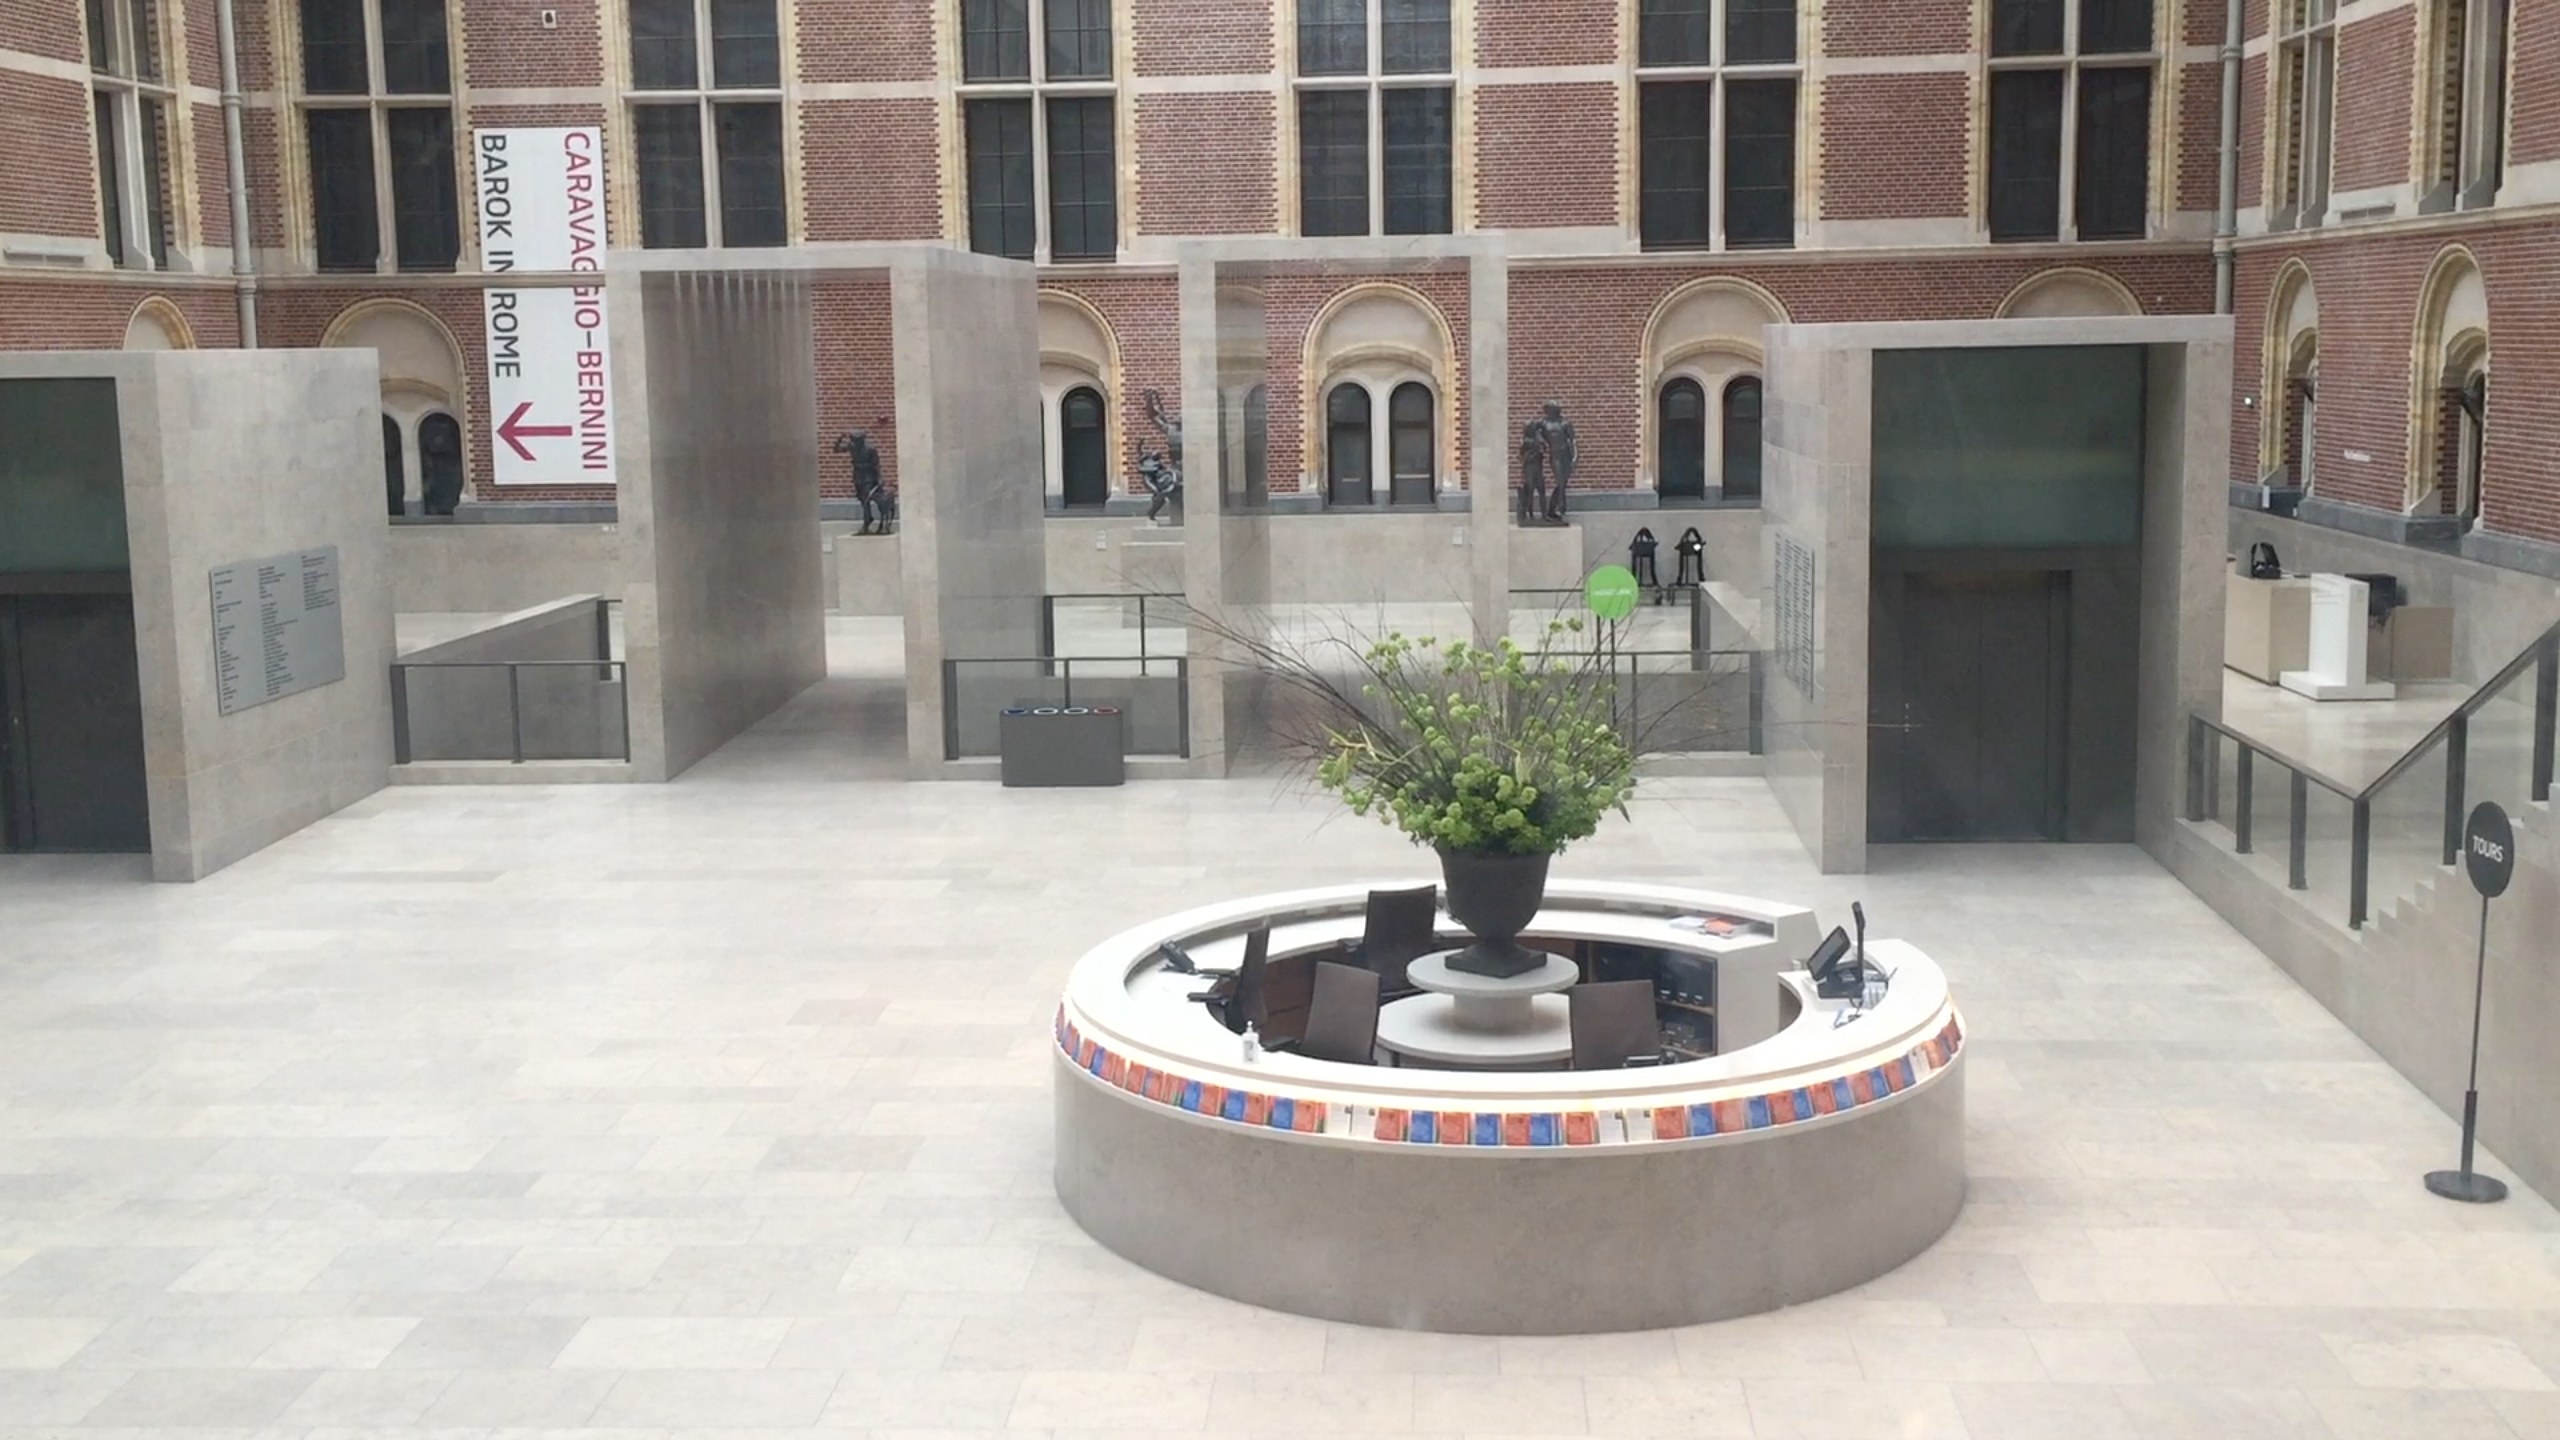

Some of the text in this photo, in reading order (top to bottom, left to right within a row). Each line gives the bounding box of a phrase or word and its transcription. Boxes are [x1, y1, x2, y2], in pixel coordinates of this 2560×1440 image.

[481, 134, 513, 239] BAROK
[491, 292, 521, 378] ROME
[2473, 834, 2504, 863] TOURS
